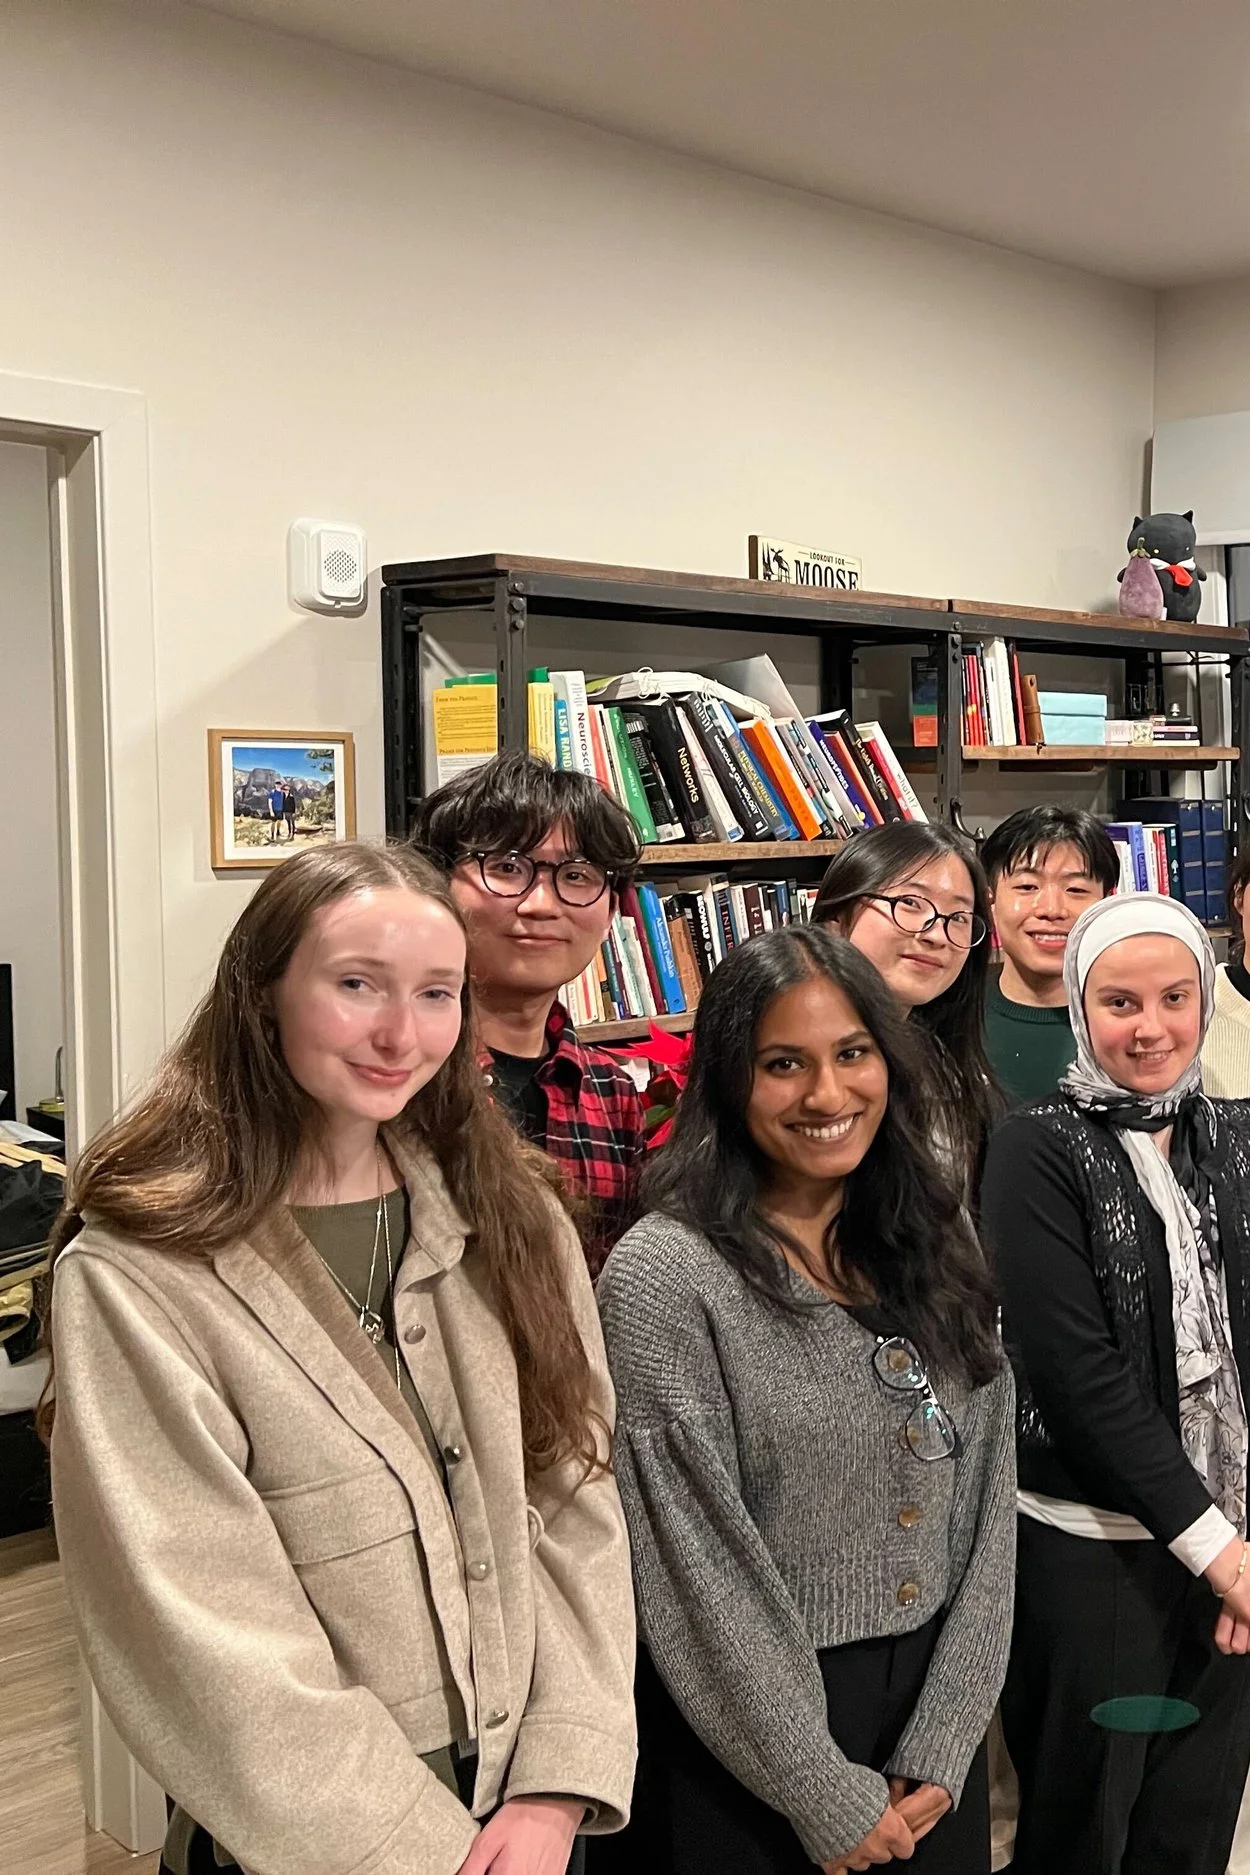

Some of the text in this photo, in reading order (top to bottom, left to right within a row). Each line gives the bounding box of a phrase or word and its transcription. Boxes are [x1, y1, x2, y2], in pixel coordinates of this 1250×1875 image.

[794, 560, 858, 591] MOOSE
[810, 552, 834, 563] LOOKOUT
[558, 708, 568, 734] LISA
[677, 747, 699, 803] Networks
[714, 734, 737, 774] MOLECULAR
[733, 772, 745, 788] CELL
[741, 786, 759, 815] BIOLOGY
[819, 739, 849, 790] NEUROPEPTIDES
[897, 773, 911, 795] what
[696, 895, 710, 940] BEOWULF
[655, 917, 668, 950] Alexander
[664, 949, 675, 978] Pushkin
